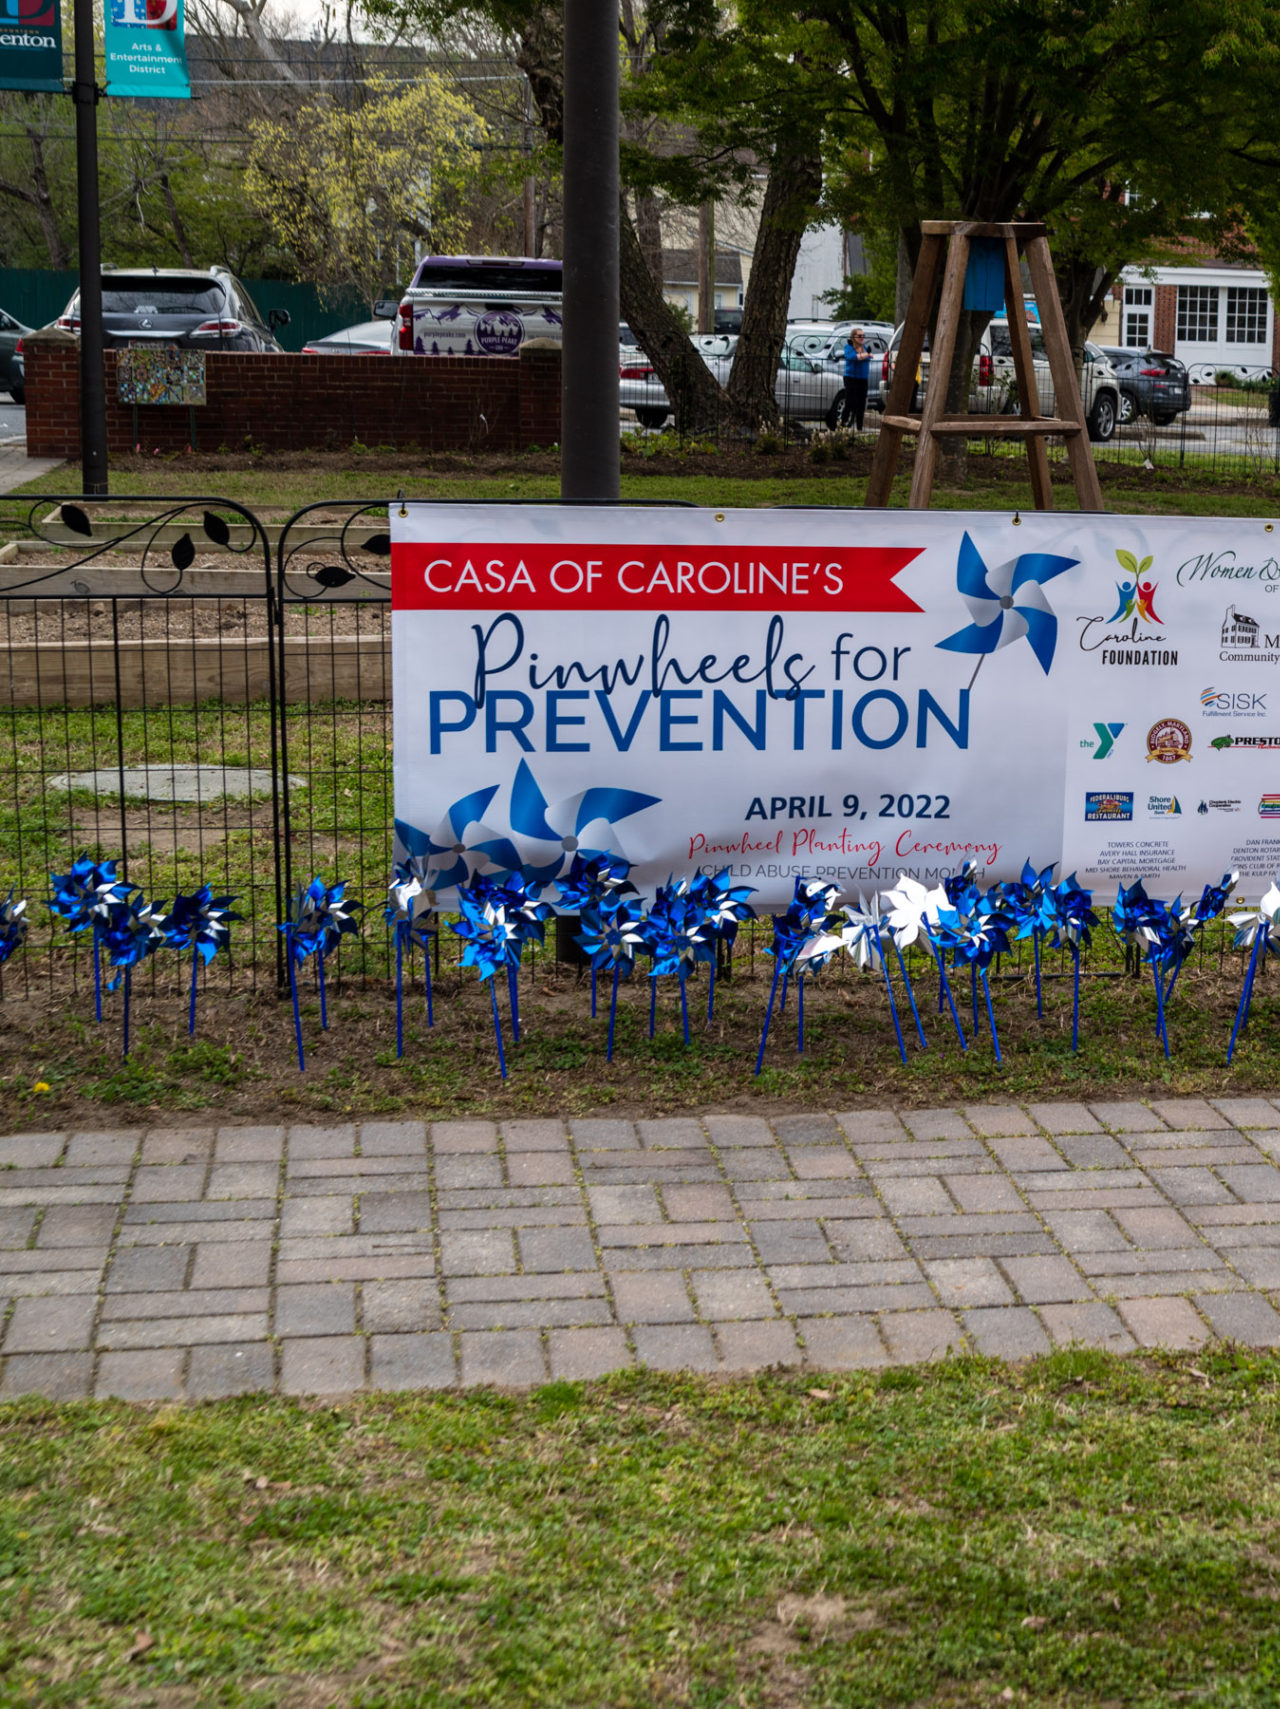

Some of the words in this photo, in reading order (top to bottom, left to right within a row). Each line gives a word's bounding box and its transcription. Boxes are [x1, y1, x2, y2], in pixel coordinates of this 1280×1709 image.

[0, 33, 56, 48] enton
[131, 43, 152, 51] Arts
[110, 53, 182, 64] Entertainment
[129, 65, 166, 74] District
[1176, 550, 1256, 587] Women
[423, 559, 537, 593] CASA
[549, 560, 603, 593] OF
[617, 561, 844, 595] CAROLINE'S
[1265, 584, 1280, 593] OF
[1076, 616, 1167, 651] Caroline
[471, 611, 816, 709] Pinwheels
[831, 632, 911, 681] for
[1102, 650, 1178, 666] FOUNDATION
[1219, 651, 1280, 664] Community
[1216, 693, 1267, 710] SISK
[428, 688, 970, 755] PREVENTION
[1080, 739, 1095, 748] the
[744, 795, 833, 821] APRIL
[842, 794, 868, 821] 9,
[878, 793, 951, 819] 2022
[1147, 803, 1173, 811] United
[1087, 812, 1130, 820] RESTAURANT
[688, 829, 783, 859] Pinwheel
[792, 827, 886, 867] Planting
[895, 829, 1003, 866] Ceremony
[755, 865, 810, 879] ABUSE
[815, 866, 921, 880] PREVENTION
